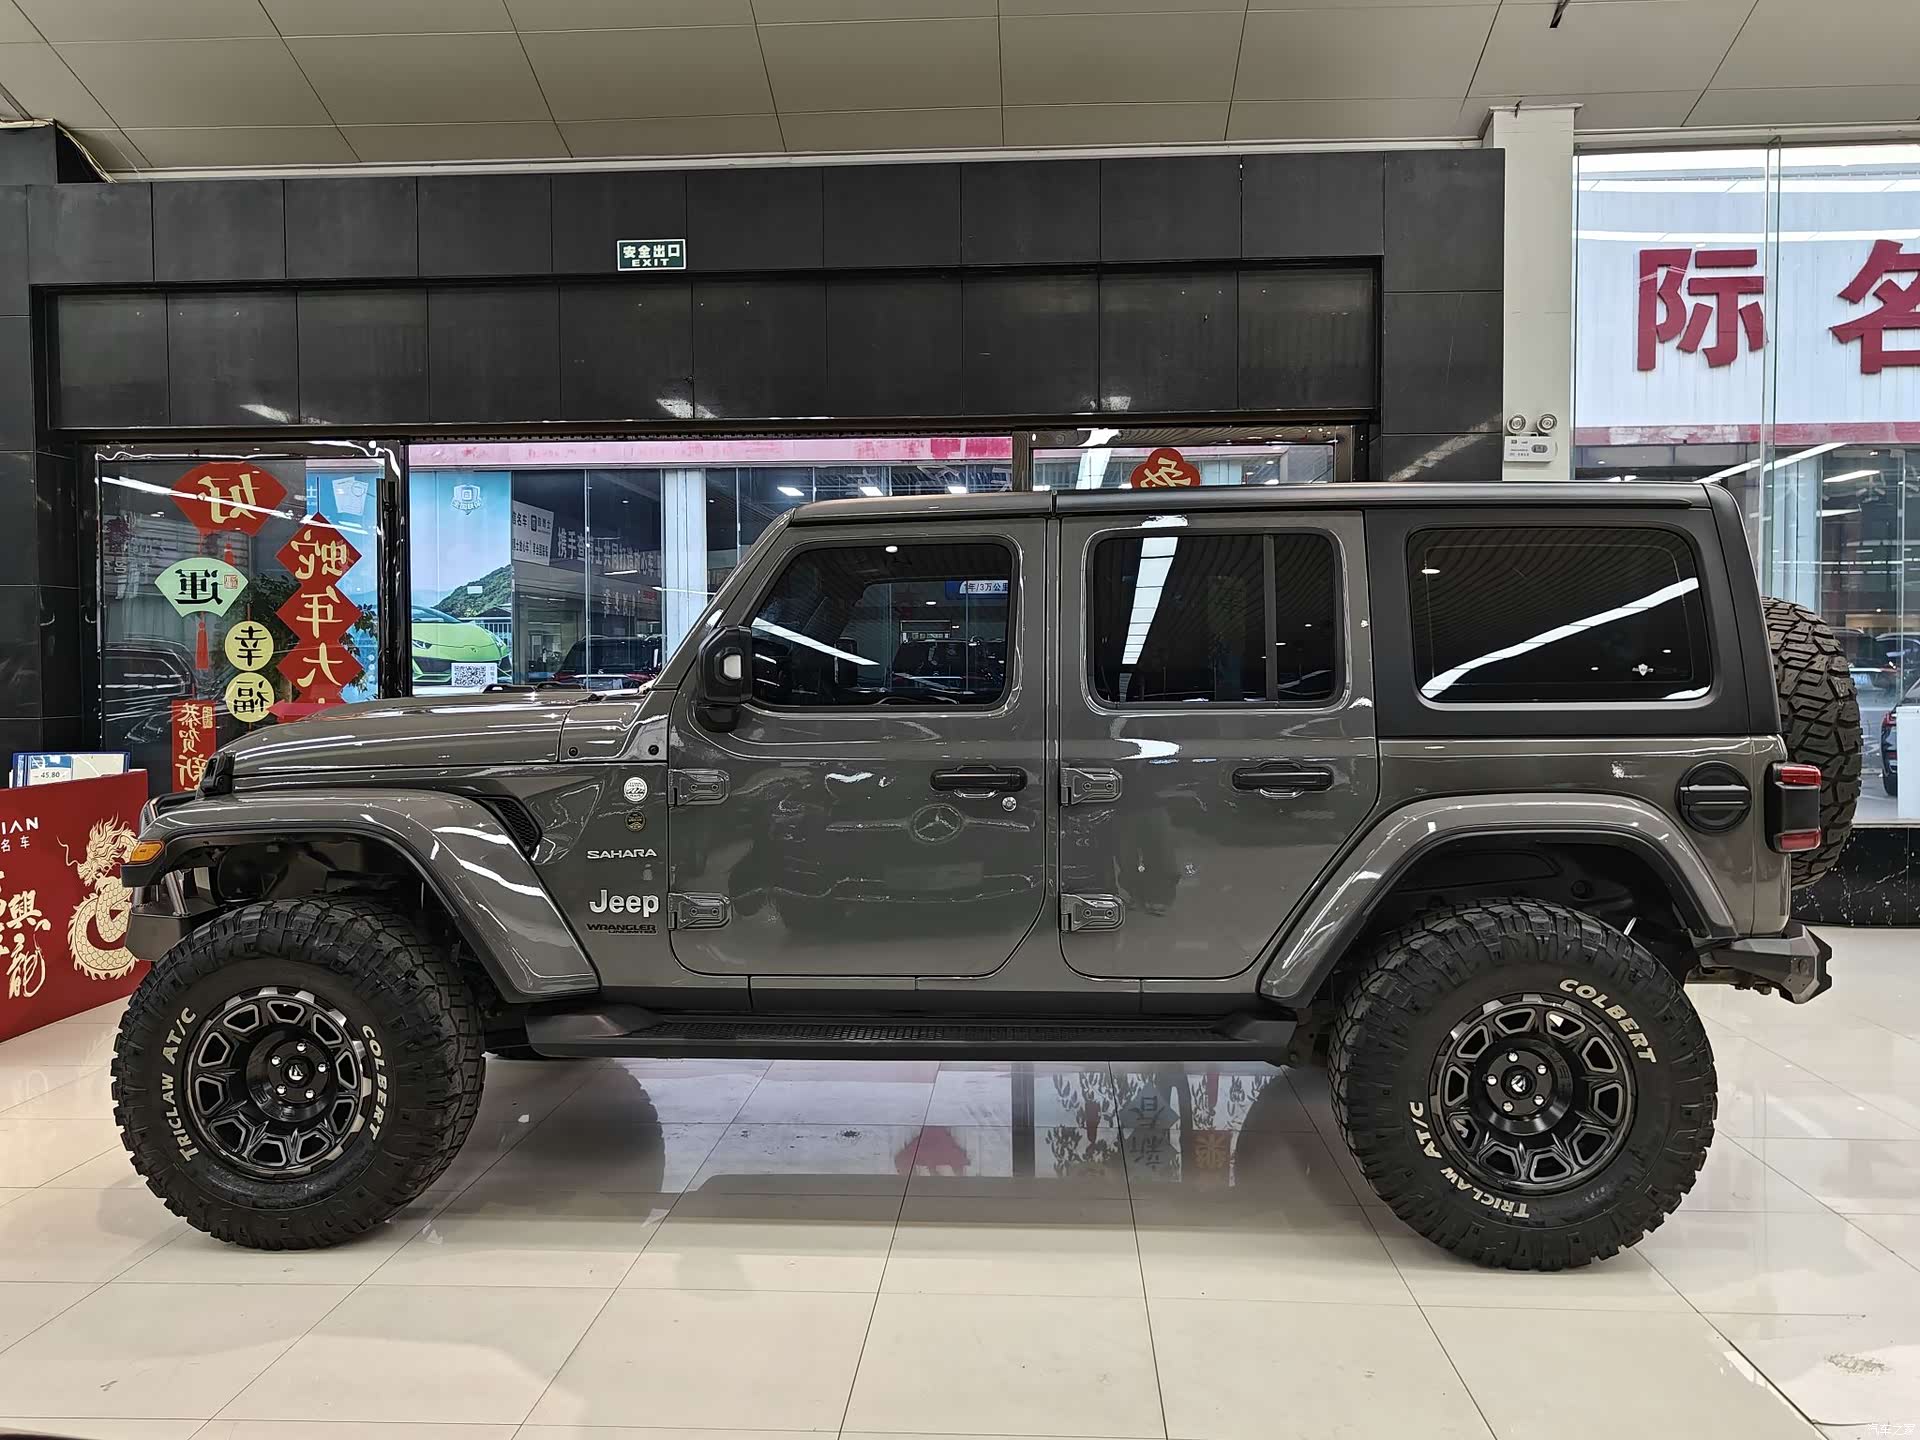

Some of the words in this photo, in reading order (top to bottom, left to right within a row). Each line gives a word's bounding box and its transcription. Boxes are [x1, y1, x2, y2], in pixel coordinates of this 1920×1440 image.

[623, 244, 680, 258] 安全出口
[632, 259, 670, 267] EXIT
[964, 583, 1008, 592] 年/3万公里
[41, 771, 60, 779] 45.80
[587, 848, 657, 859] SAHARA
[589, 889, 659, 917] Jeep
[587, 923, 656, 931] WRANGLER
[1559, 978, 1657, 1063] COLBERT
[162, 1007, 198, 1065] AT/C
[362, 1025, 389, 1141] COLBERT
[161, 1073, 199, 1162] TRICLAW
[1408, 1101, 1443, 1160] AT/C
[1440, 1167, 1531, 1219] TRICLAW
